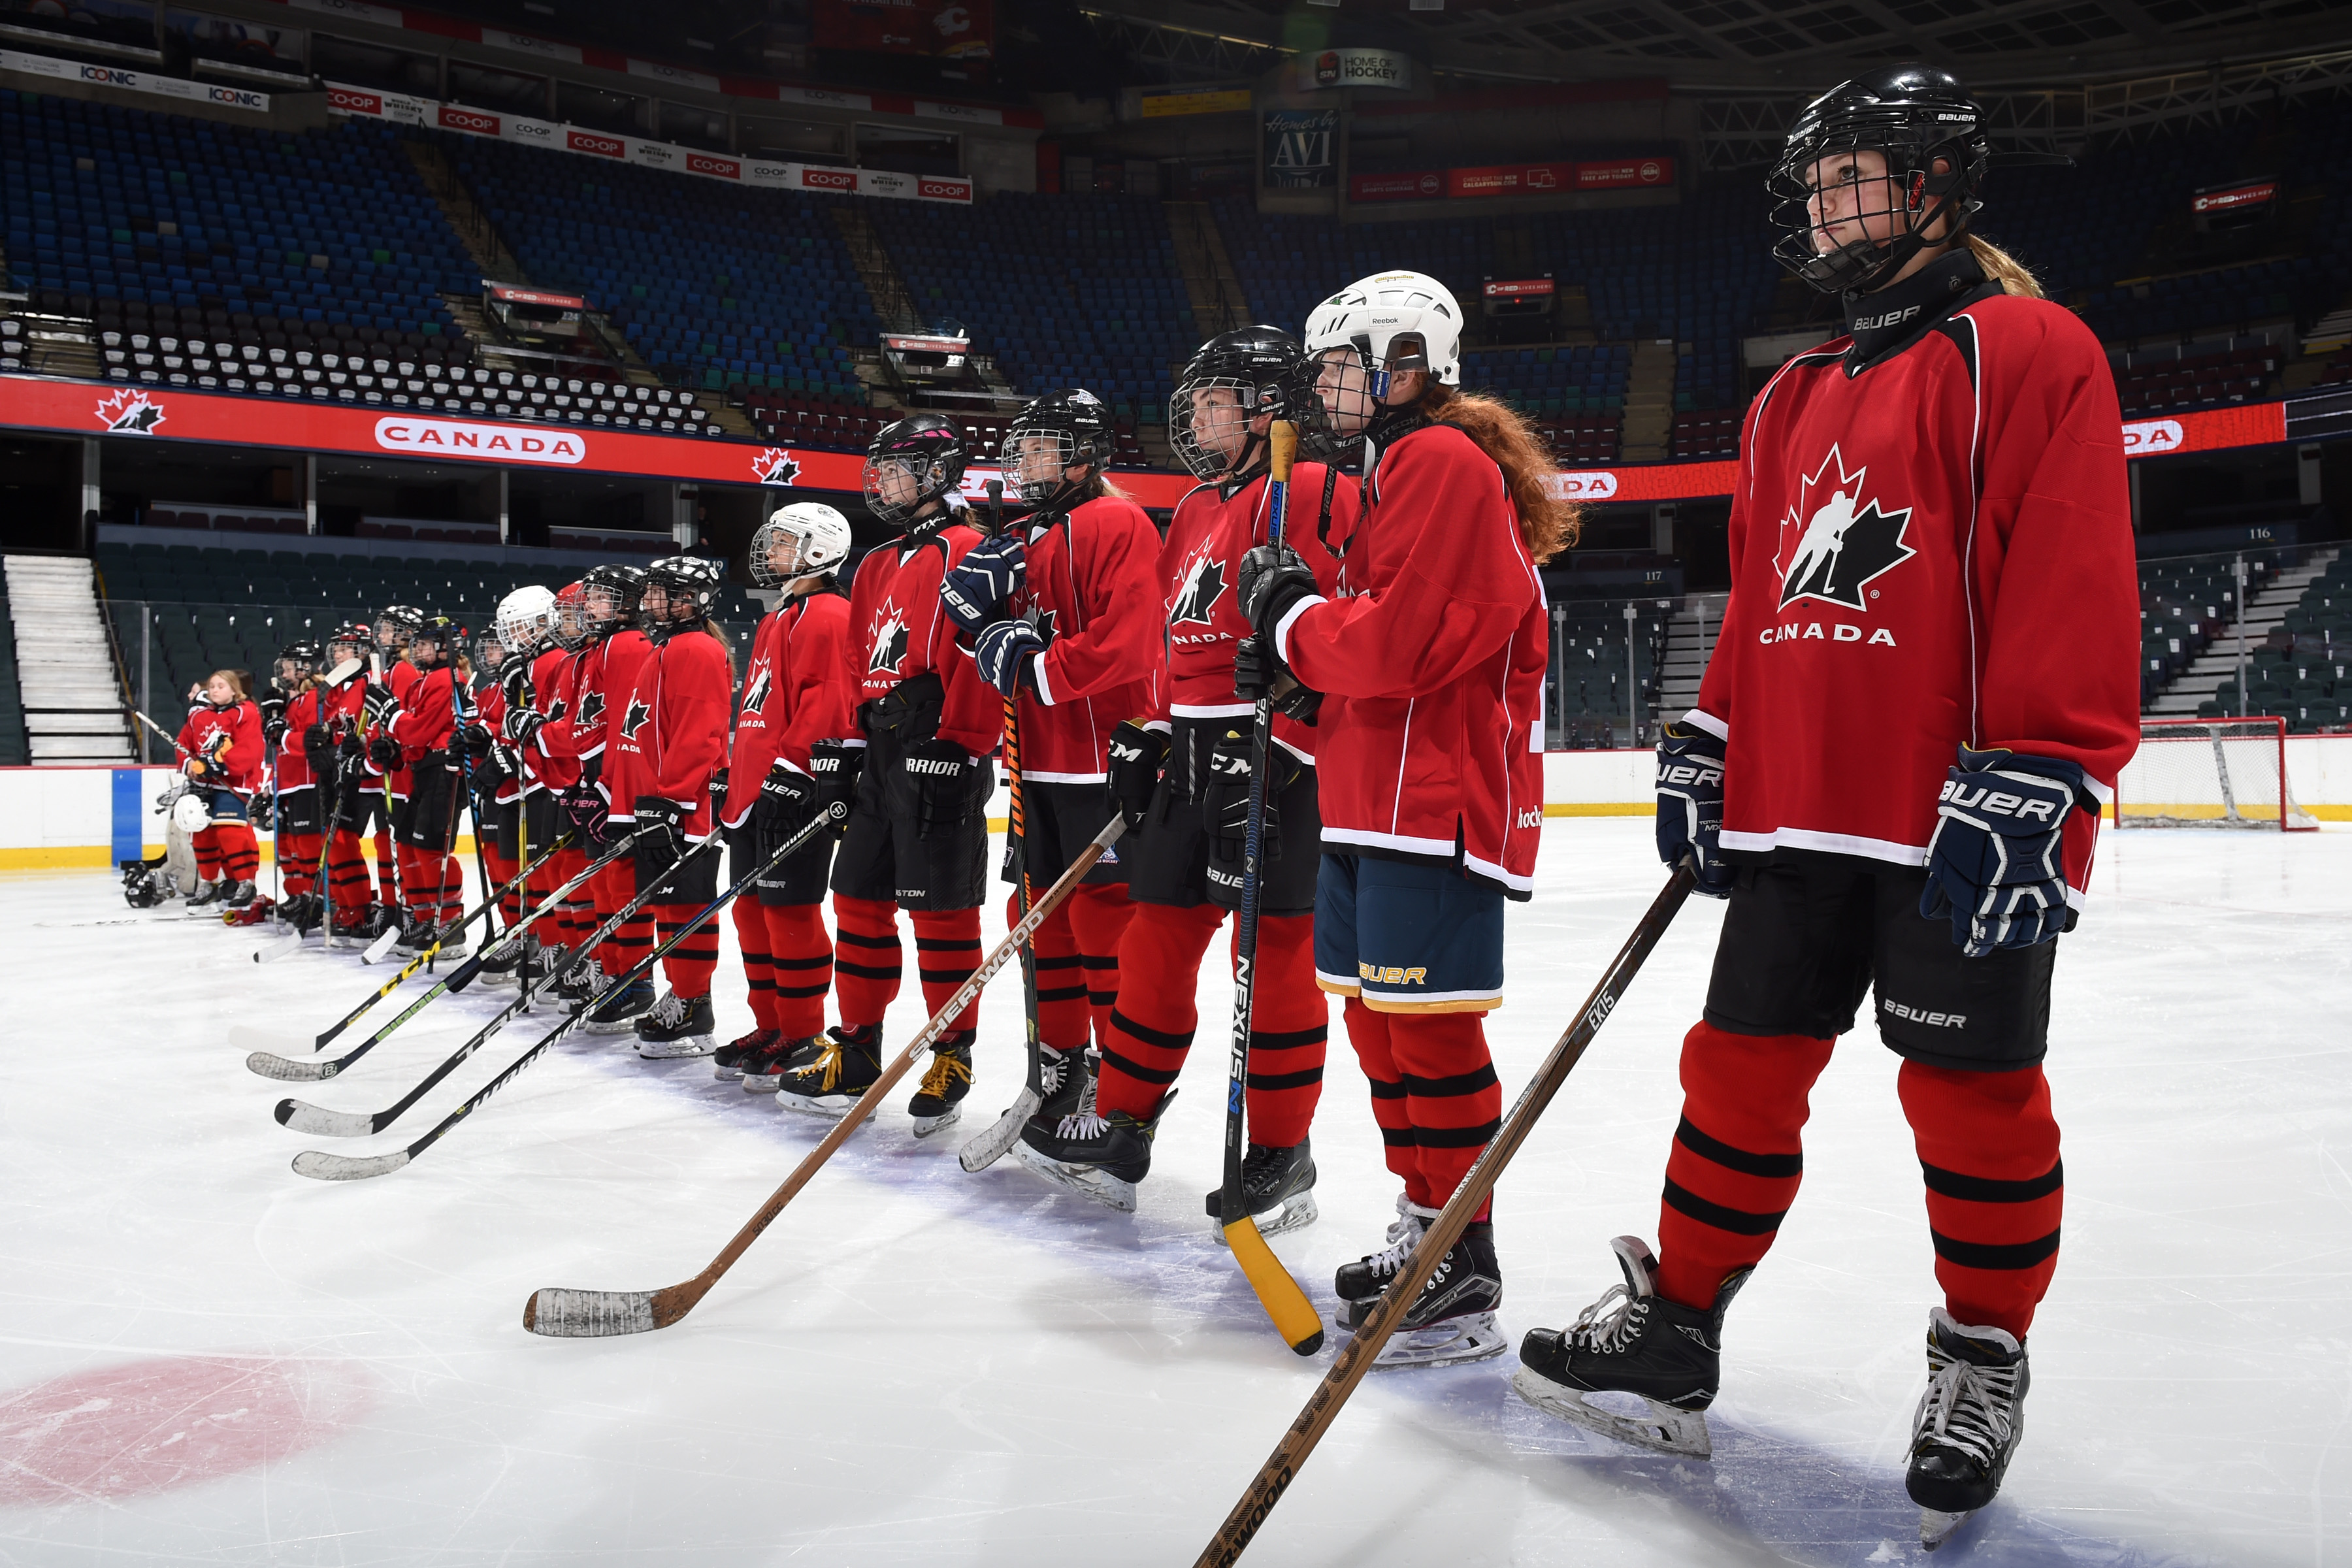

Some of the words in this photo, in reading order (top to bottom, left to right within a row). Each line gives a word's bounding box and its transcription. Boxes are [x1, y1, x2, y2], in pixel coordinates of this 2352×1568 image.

[1345, 57, 1377, 67] HOME
[1379, 57, 1394, 67] OF
[80, 66, 136, 86] ICONIC
[1345, 67, 1397, 80] HOCKEY
[209, 87, 261, 106] ICONIC
[327, 92, 374, 108] CO-OP
[384, 101, 423, 114] WHISKY
[446, 113, 493, 129] CO-OP
[1265, 114, 1318, 133] Homes
[1320, 110, 1339, 131] by
[1937, 113, 1976, 122] BAUER
[515, 123, 551, 135] CO-OP
[1788, 120, 1821, 145] BAUER
[574, 137, 618, 152] CO-OP
[1269, 131, 1331, 168] AVI
[638, 148, 672, 159] WHISKY
[693, 159, 734, 173] CO-OP
[754, 167, 787, 176] CO-OP
[809, 174, 851, 186] CO-OP
[870, 179, 904, 188] WHISKY
[924, 184, 965, 196] CO-OP
[2217, 195, 2235, 204] RED
[2235, 192, 2257, 201] LIVES
[1854, 305, 1921, 331] BAUER
[1252, 355, 1282, 364] BAUER
[1260, 401, 1284, 413] BAUER
[384, 425, 576, 456] CANADA
[1333, 435, 1365, 448] AUE
[941, 448, 959, 457] BAUER
[1322, 465, 1336, 515] BAUER
[1271, 482, 1281, 536] NEXUS
[817, 524, 837, 536] BAUER
[2249, 527, 2271, 540] 116
[807, 564, 825, 573] BAUER
[1646, 571, 1662, 581] 117
[1759, 622, 1897, 647] CANADA
[509, 866, 534, 891] TACKS
[1207, 865, 1264, 889] BAUE
[380, 941, 441, 998] CCM
[907, 910, 1045, 1064] SHER-WOOD
[375, 981, 448, 1042] BIGGIE
[457, 971, 556, 1061] TRUE
[1230, 954, 1250, 1081] NEXUS
[1588, 989, 1615, 1032] EK15
[1884, 998, 1967, 1030] BAUER
[471, 1006, 595, 1112] WARRIOR
[1452, 1165, 1478, 1200] REKKER
[752, 1201, 784, 1236] 5030CC
[1427, 1290, 1458, 1318] BAUER
